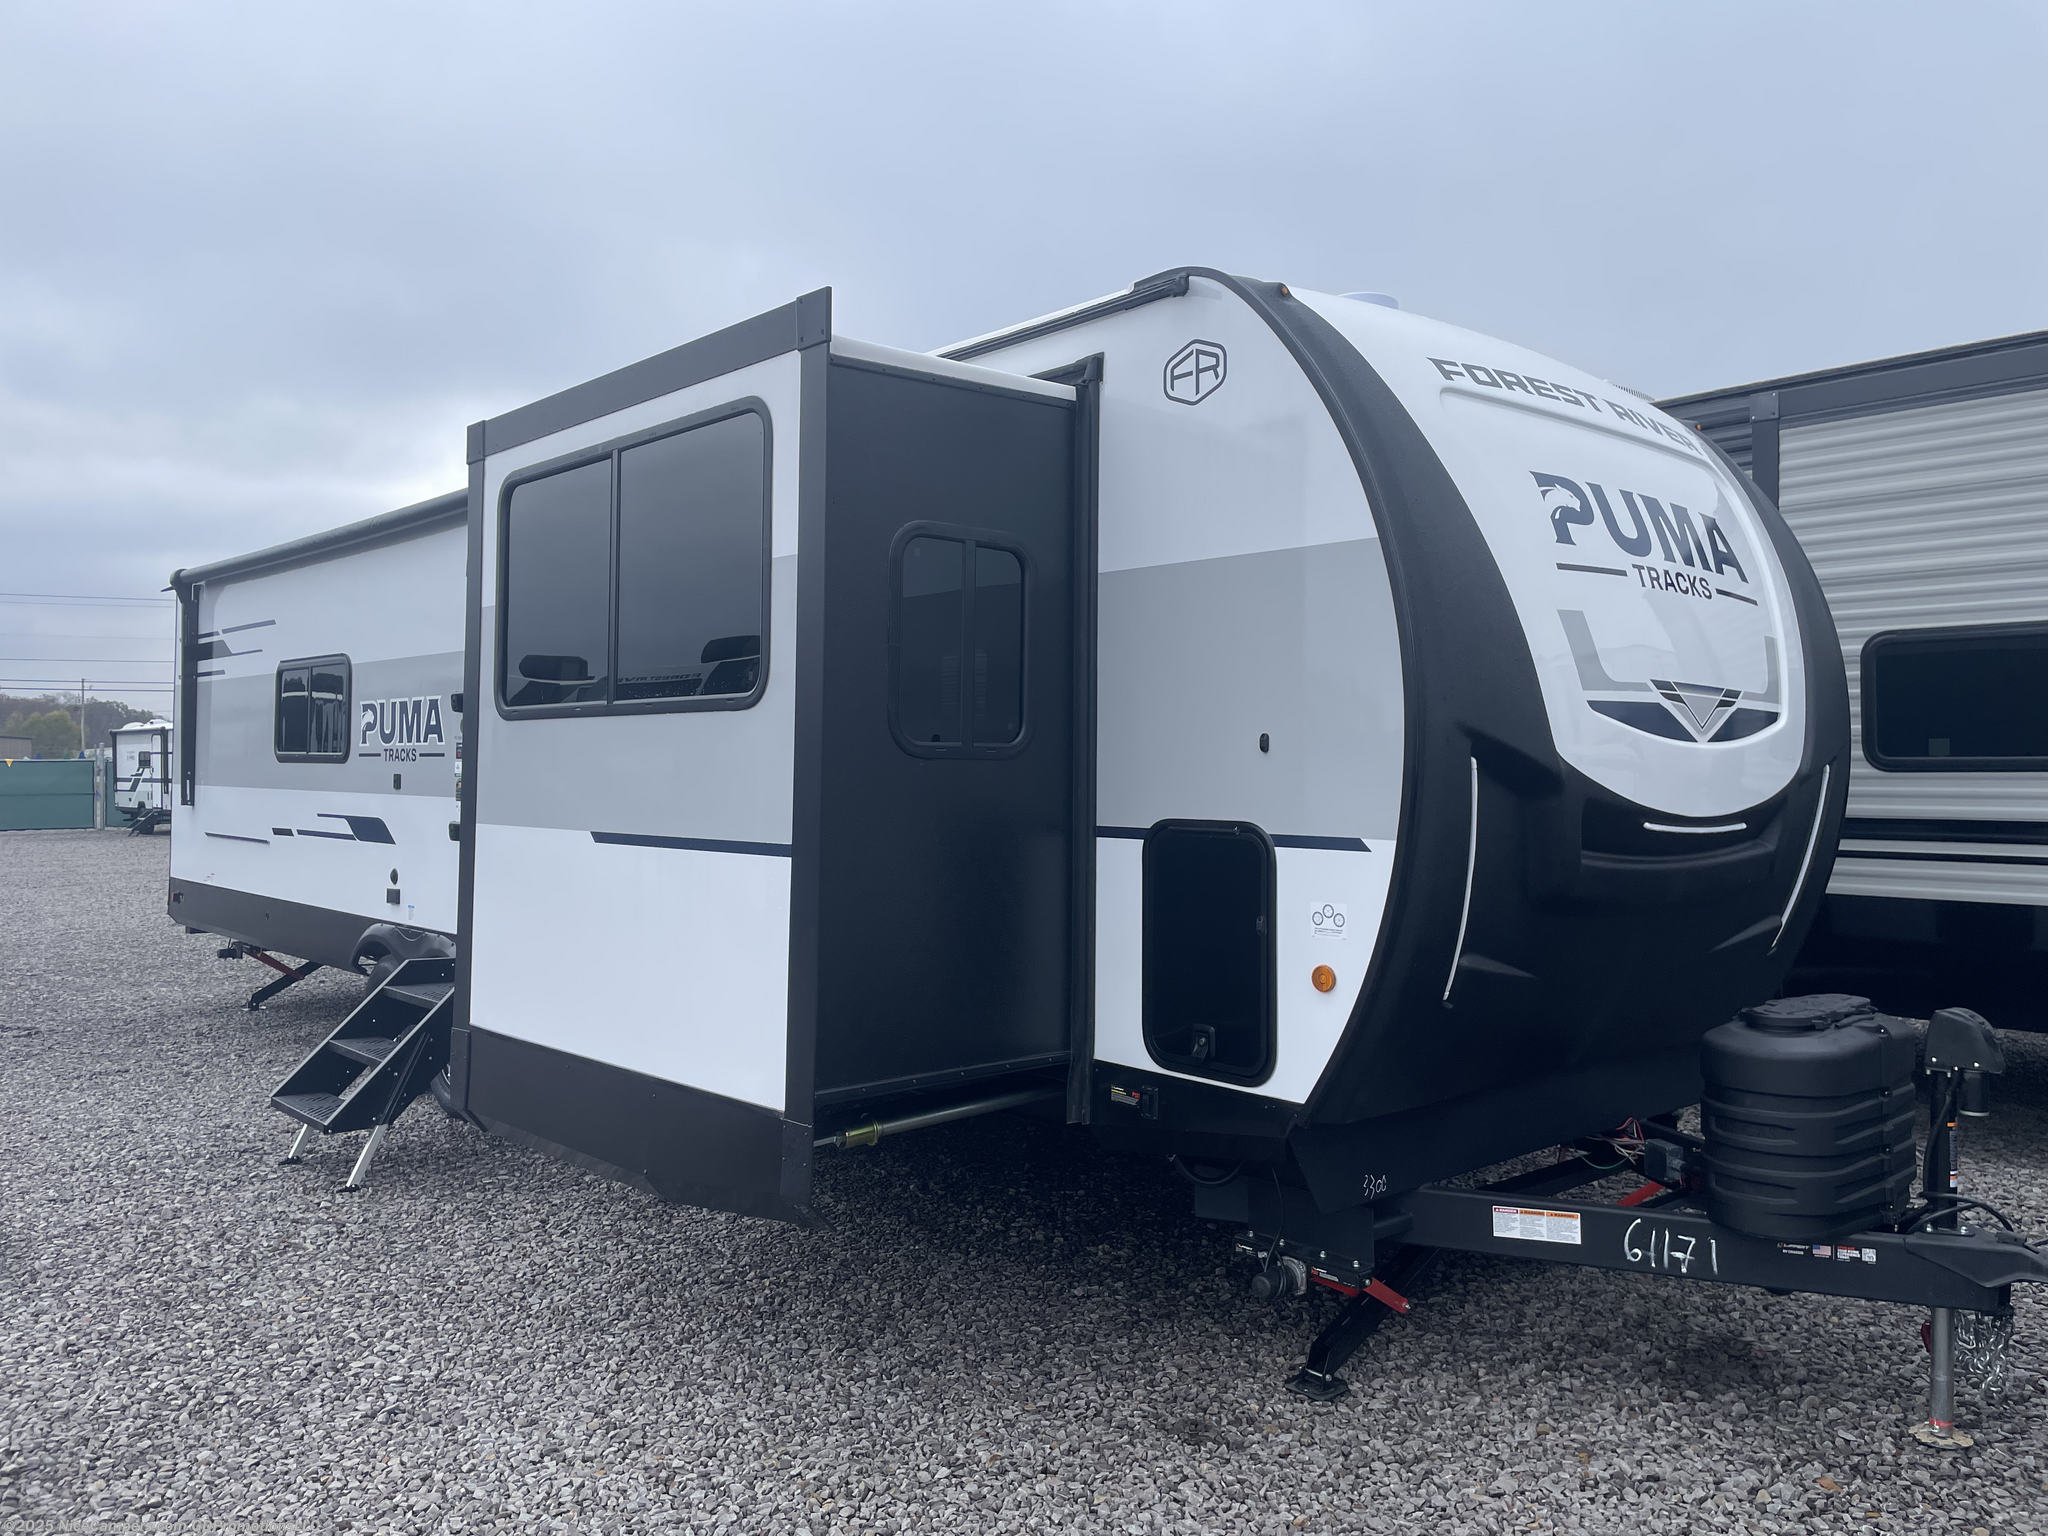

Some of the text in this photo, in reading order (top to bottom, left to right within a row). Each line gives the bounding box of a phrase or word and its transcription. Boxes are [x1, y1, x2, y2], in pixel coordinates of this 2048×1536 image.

[1426, 357, 1704, 456] FOREST RIVER
[1529, 471, 1749, 584] PUMA
[1632, 564, 1713, 600] TRACKS
[359, 695, 445, 746] PUMA
[383, 748, 417, 762] TRACKS
